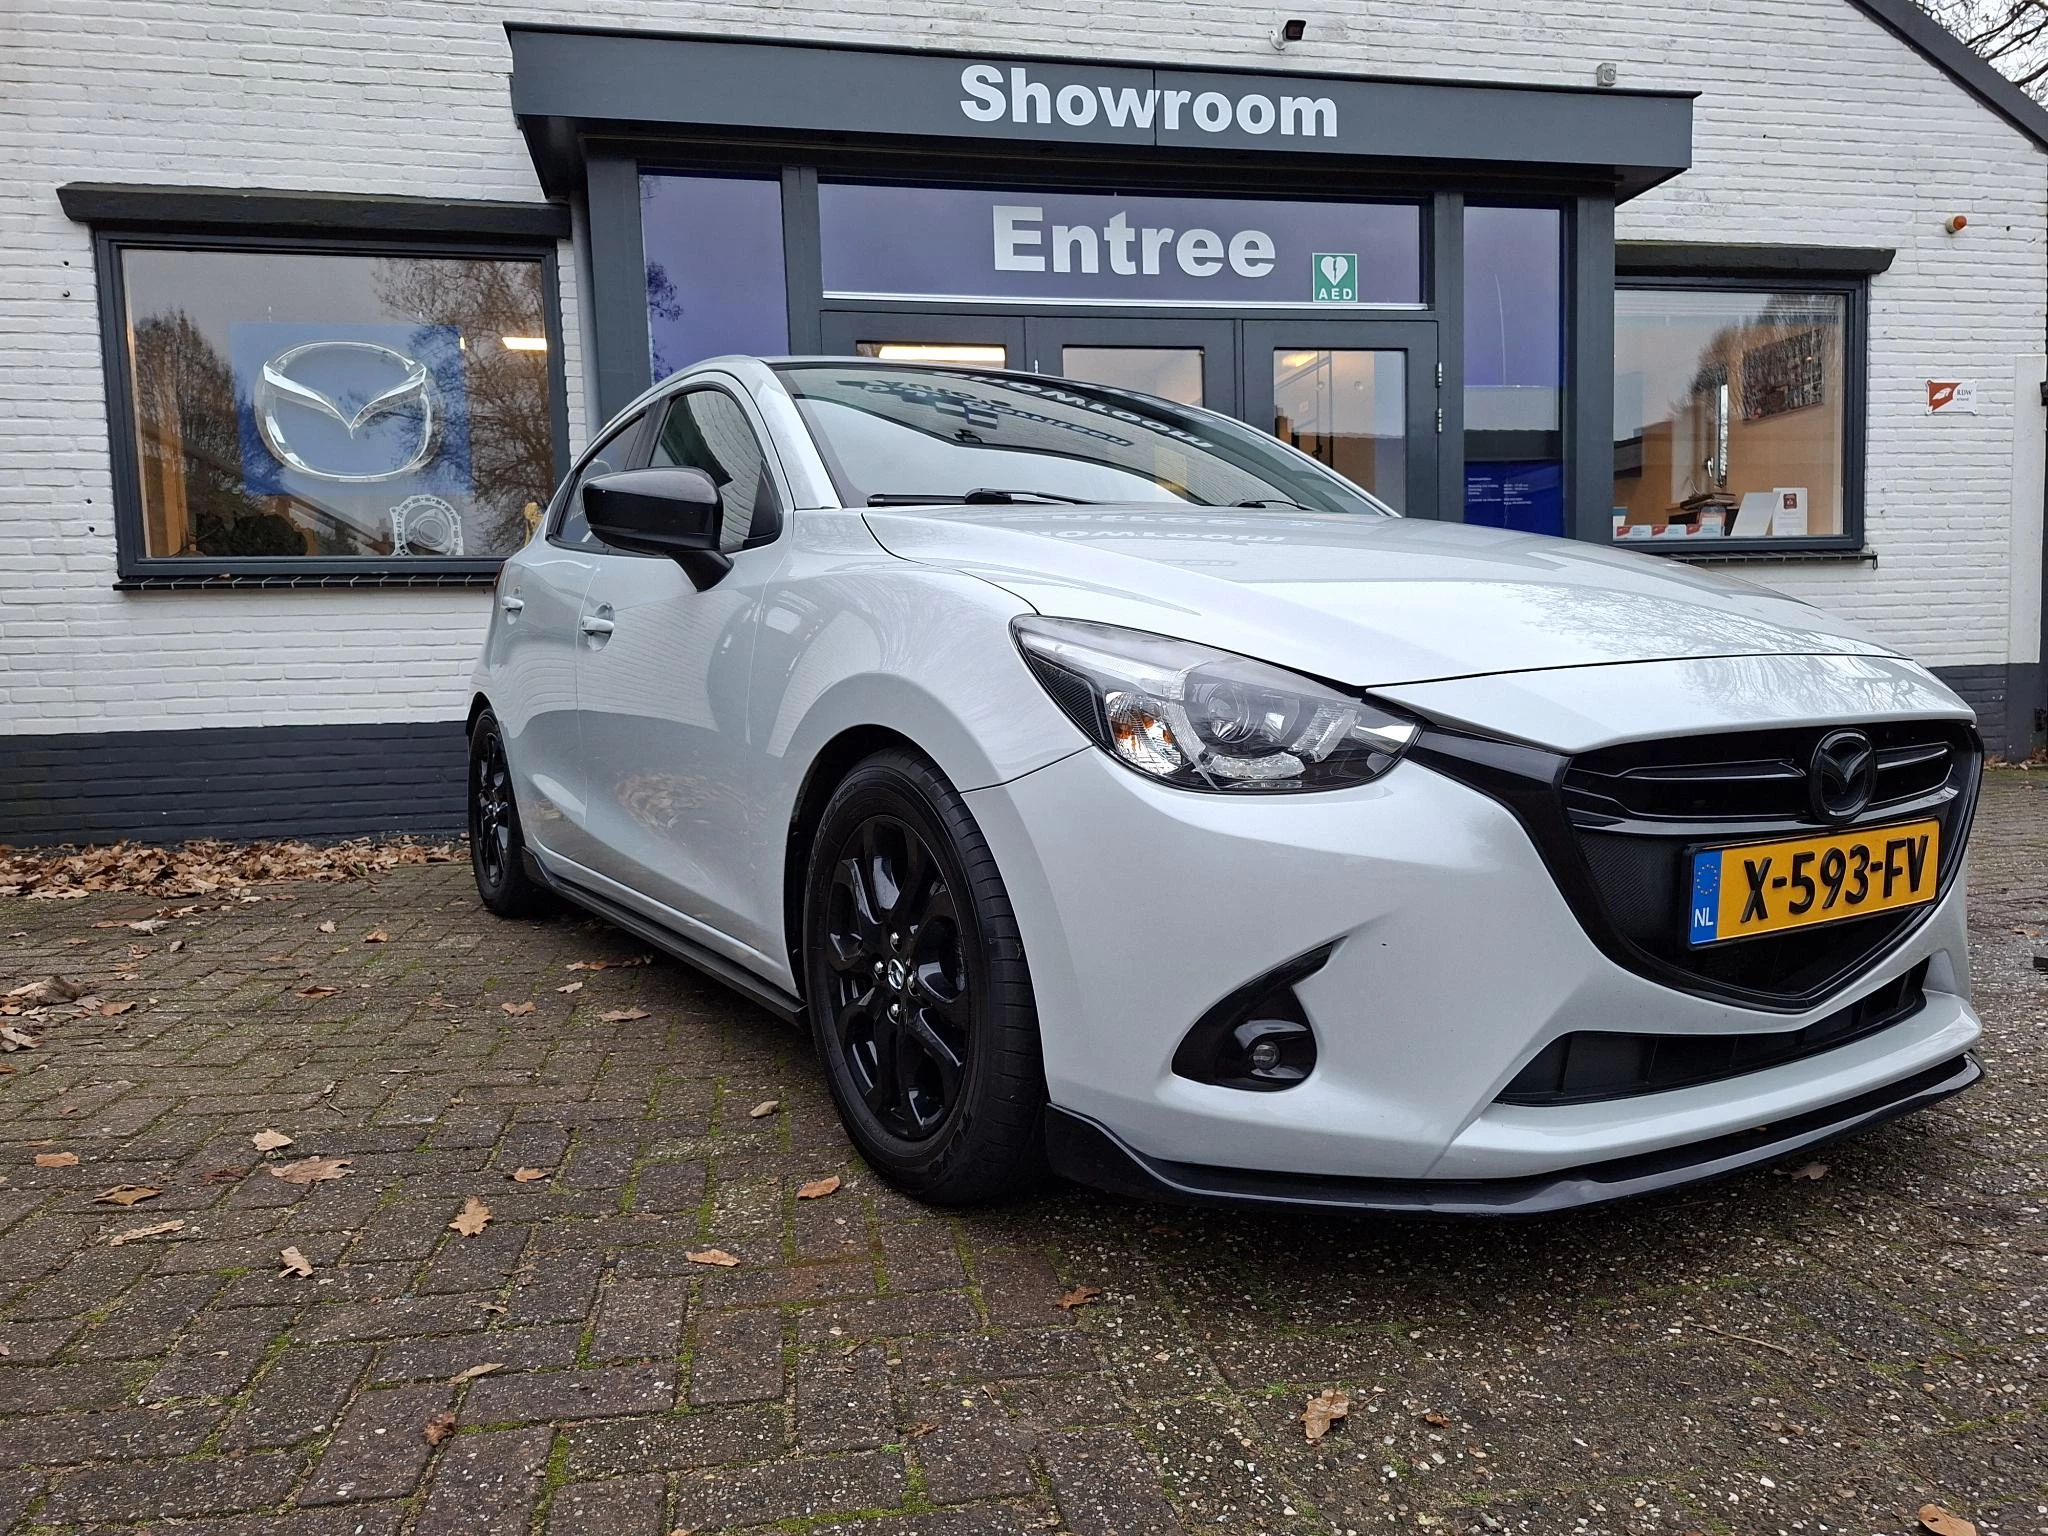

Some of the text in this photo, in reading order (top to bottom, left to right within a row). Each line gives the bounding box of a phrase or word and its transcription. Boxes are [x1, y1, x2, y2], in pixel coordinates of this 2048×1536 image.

[960, 64, 1337, 137] Showroom
[992, 205, 1275, 277] Entree
[1318, 288, 1352, 300] AED
[1740, 835, 1929, 923] X-593-FV
[1694, 907, 1714, 928] NL
